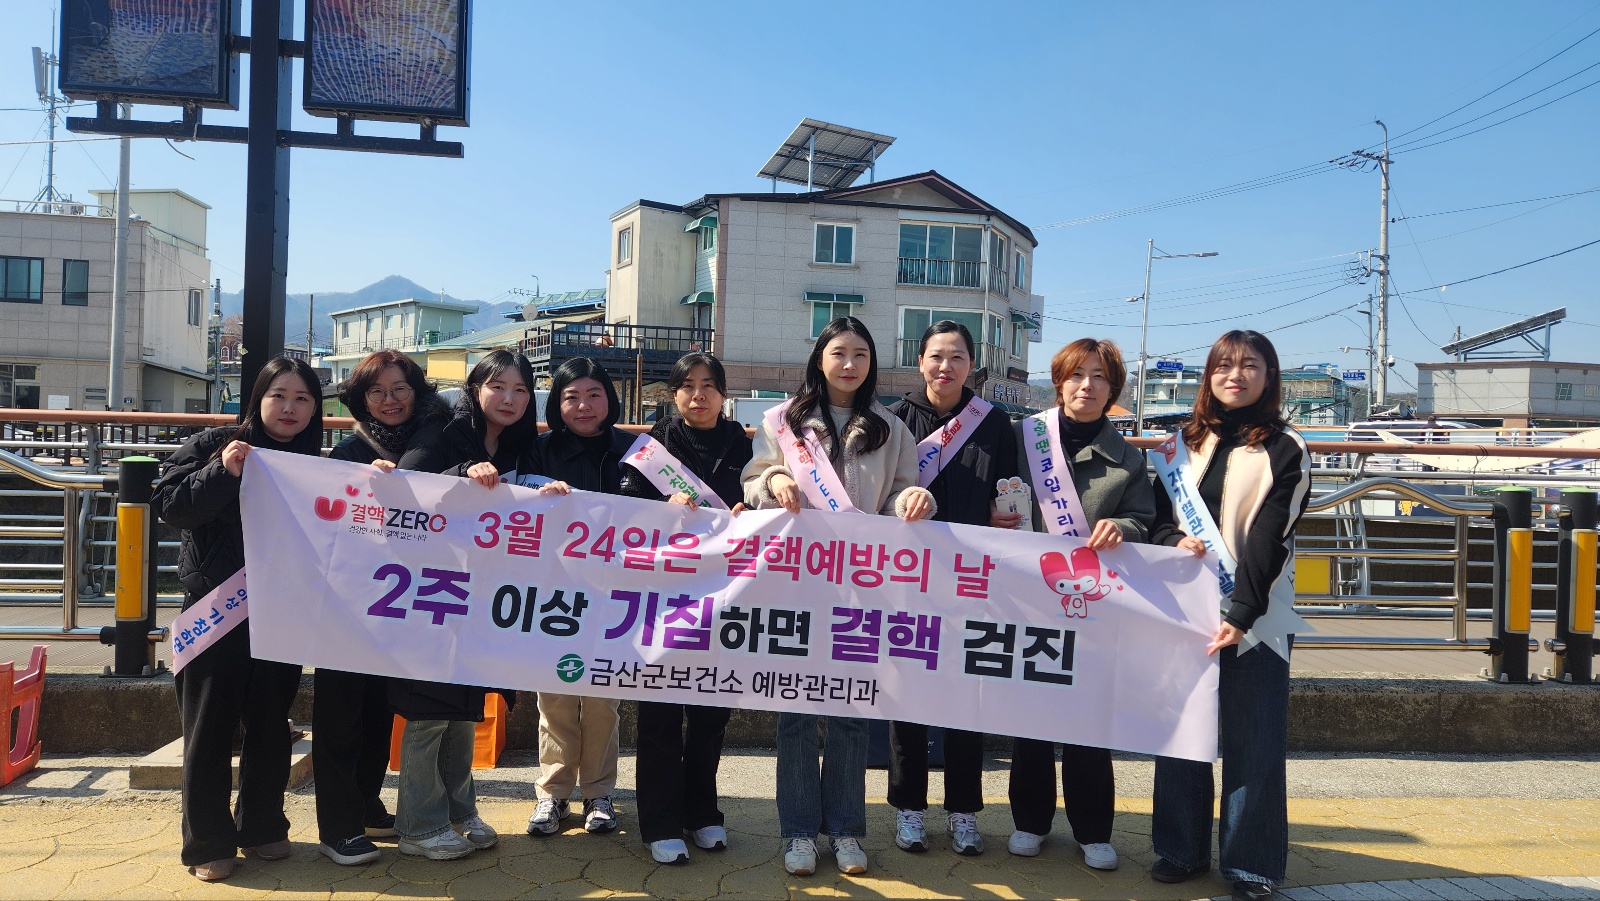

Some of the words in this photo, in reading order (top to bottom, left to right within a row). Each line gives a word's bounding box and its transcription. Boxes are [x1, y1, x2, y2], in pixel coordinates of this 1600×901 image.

[1036, 438, 1050, 454] 땐
[1041, 457, 1054, 473] 코
[1044, 475, 1061, 493] 입
[473, 510, 544, 558] 3월
[563, 521, 702, 574] 24일은
[724, 533, 930, 594] 결핵예방의
[953, 553, 996, 600] 날
[174, 607, 225, 654] 기침하면
[366, 563, 472, 626] 2주
[491, 584, 589, 637] 이상
[604, 589, 810, 658] 기침하면
[830, 606, 942, 672] 결핵
[963, 621, 1077, 686] 검진
[591, 658, 744, 696] 금산군보건소
[751, 671, 880, 708] 예방관리과
